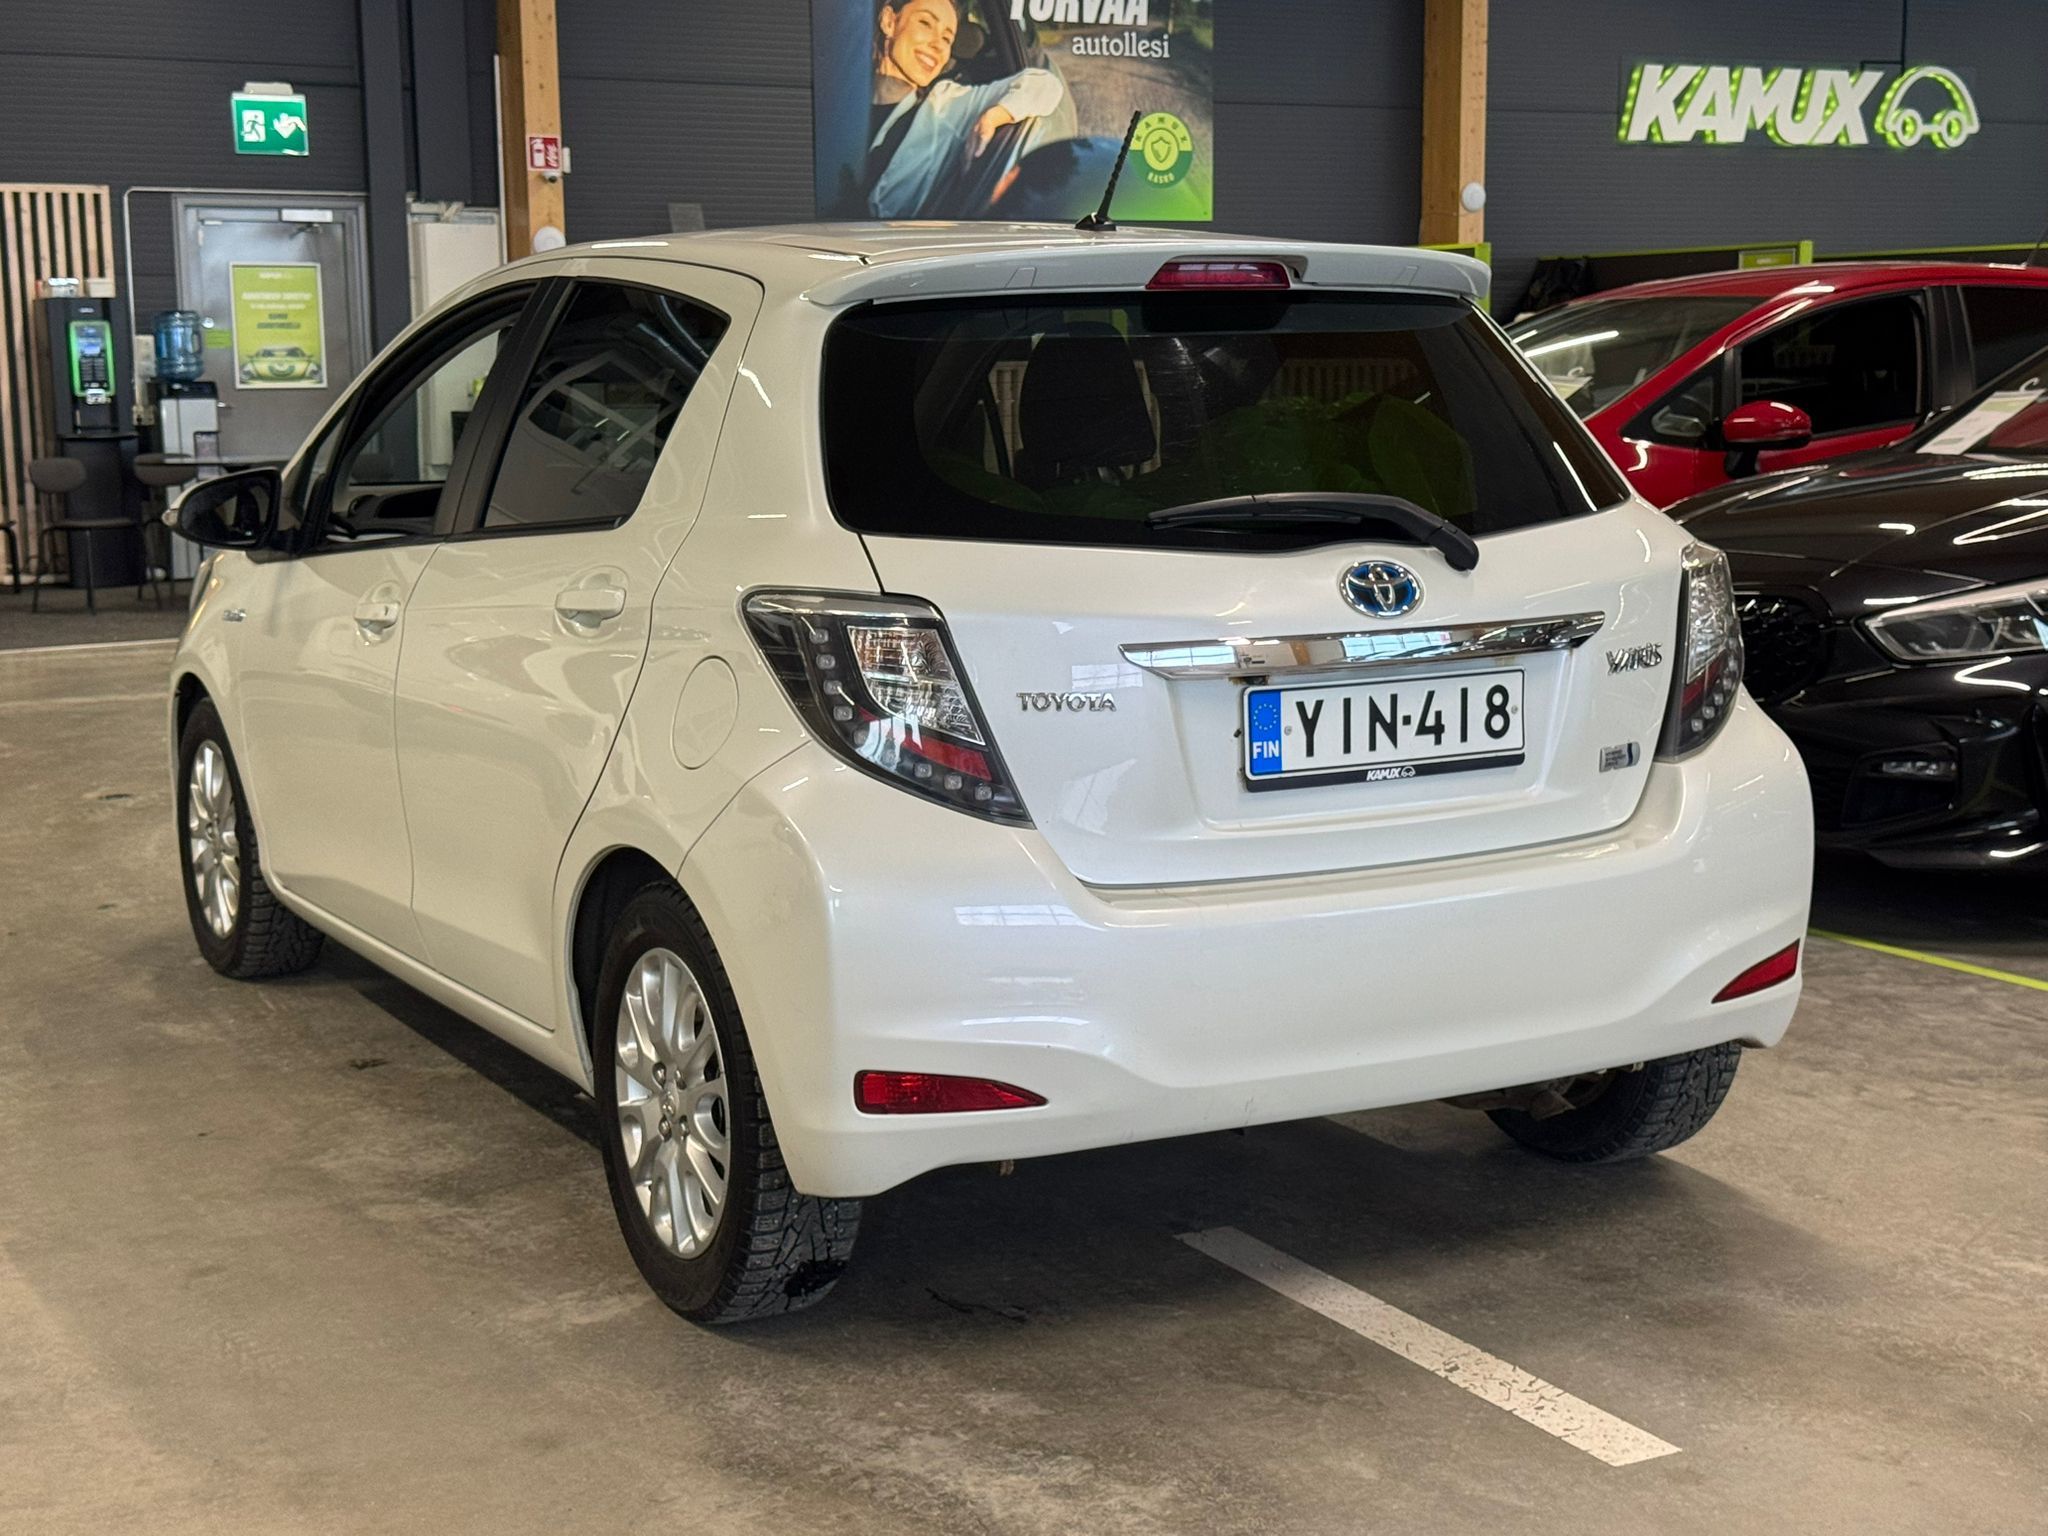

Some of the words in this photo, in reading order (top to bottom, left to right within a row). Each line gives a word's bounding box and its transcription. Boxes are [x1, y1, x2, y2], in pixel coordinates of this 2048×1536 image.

[1072, 32, 1170, 58] autollesi
[1620, 64, 1884, 146] KAMUX
[1016, 692, 1117, 712] TOYOTA
[1252, 739, 1280, 759] FIN
[1366, 767, 1401, 781] KAMUX
